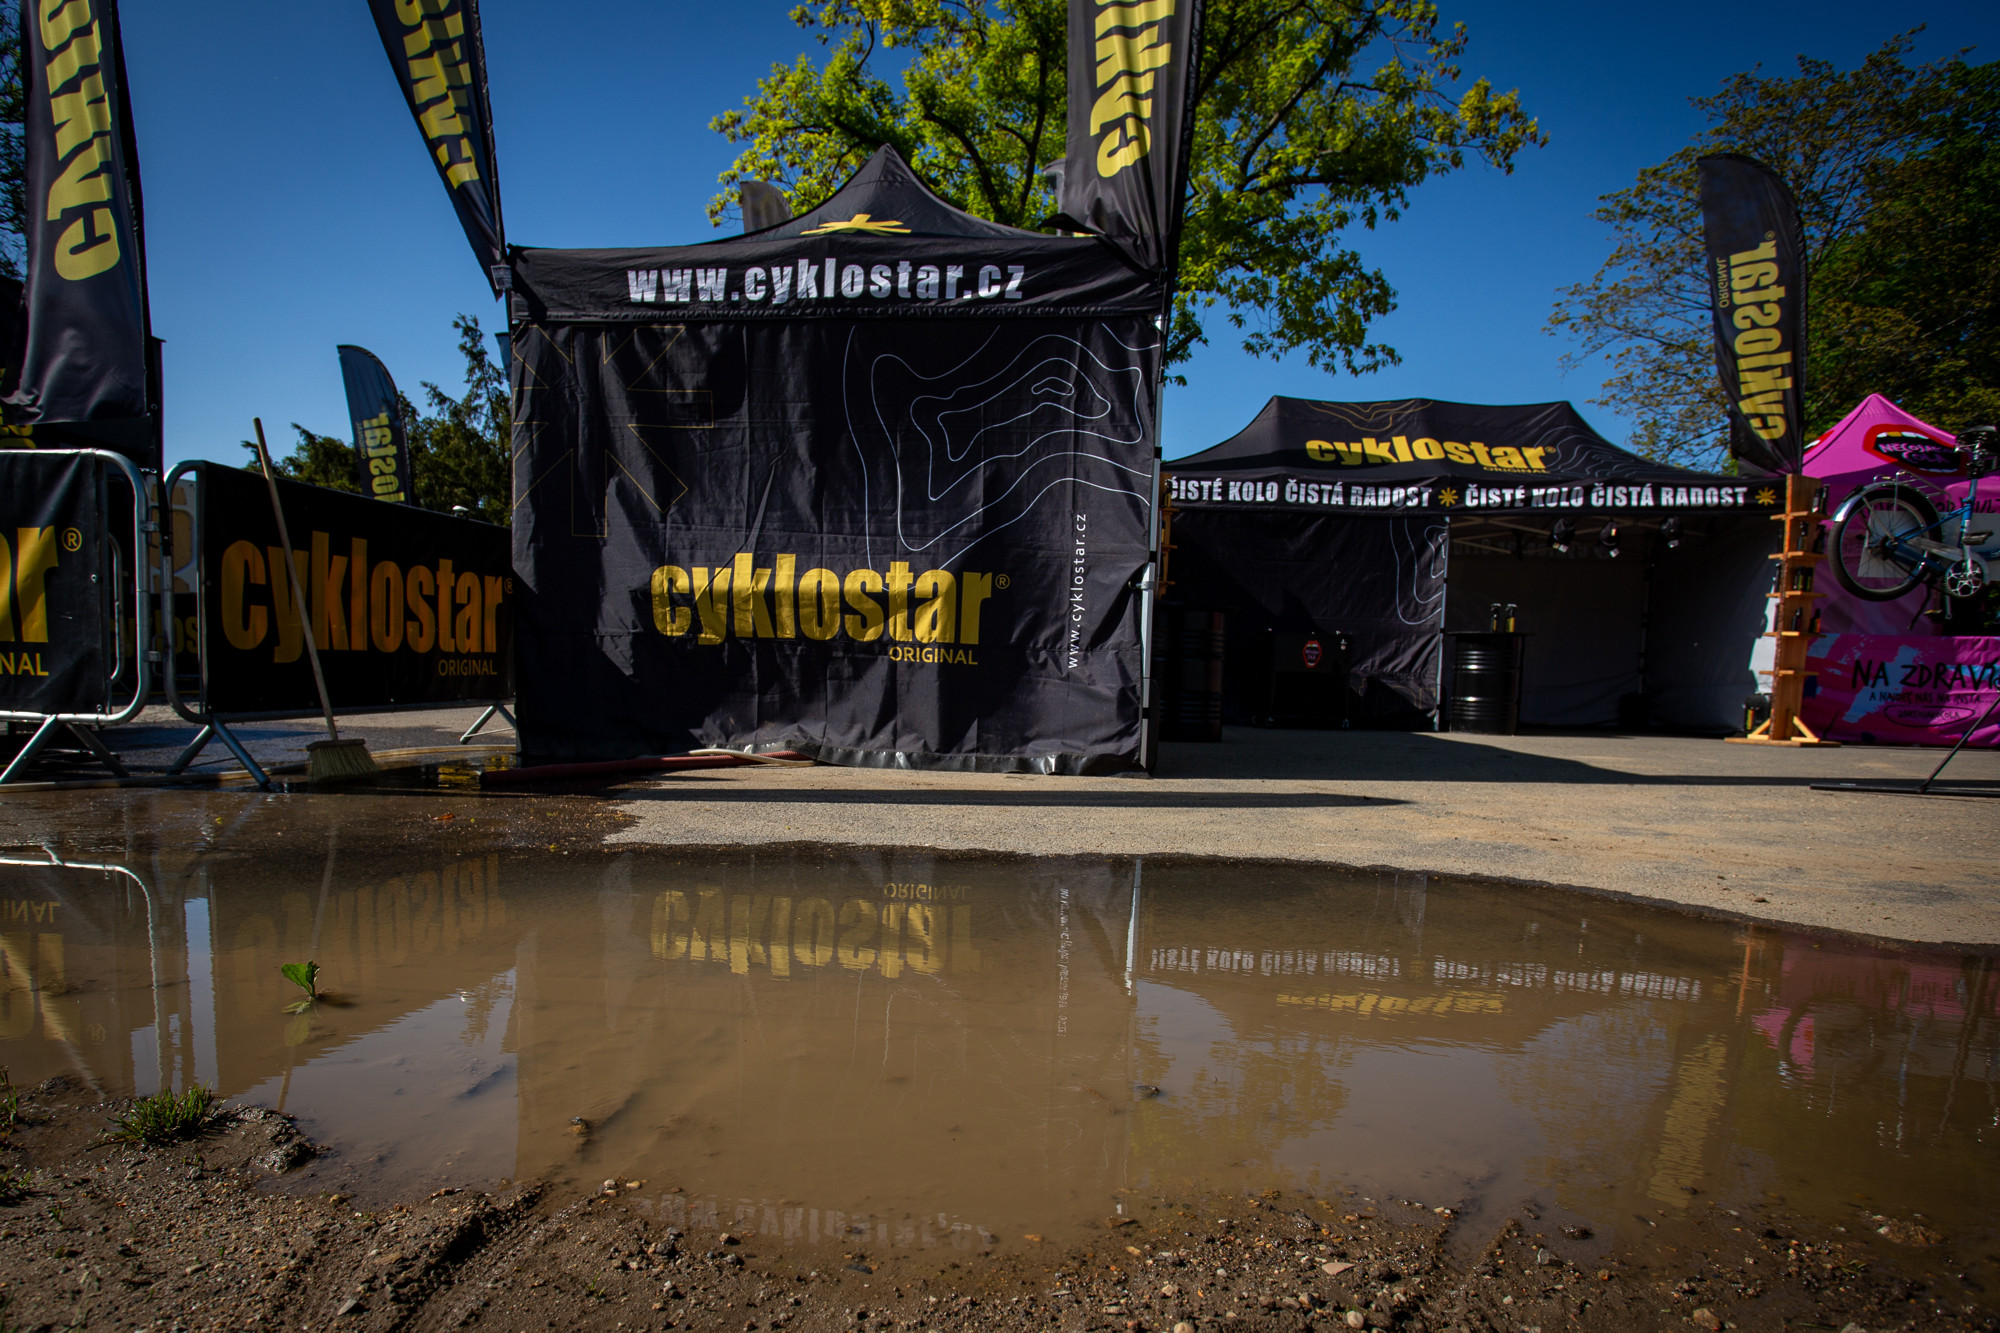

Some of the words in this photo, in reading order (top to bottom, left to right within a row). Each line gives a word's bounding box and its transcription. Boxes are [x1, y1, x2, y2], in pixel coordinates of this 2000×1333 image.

[627, 258, 1025, 305] www.cyklostar.cz
[1228, 480, 1279, 502] KOLO
[1285, 478, 1344, 505] ČISTÁ
[1350, 485, 1432, 507] RADOST
[1465, 484, 1525, 507] ČISTÉ
[1531, 487, 1584, 507] KOLO
[1591, 483, 1653, 506] ČISTÁ
[1660, 486, 1748, 507] RADOST
[1067, 513, 1087, 669] www.cyklostar.cz
[438, 658, 498, 676] ORIGINAL
[889, 646, 978, 665] ORIGINAL
[1852, 660, 1890, 689] NA
